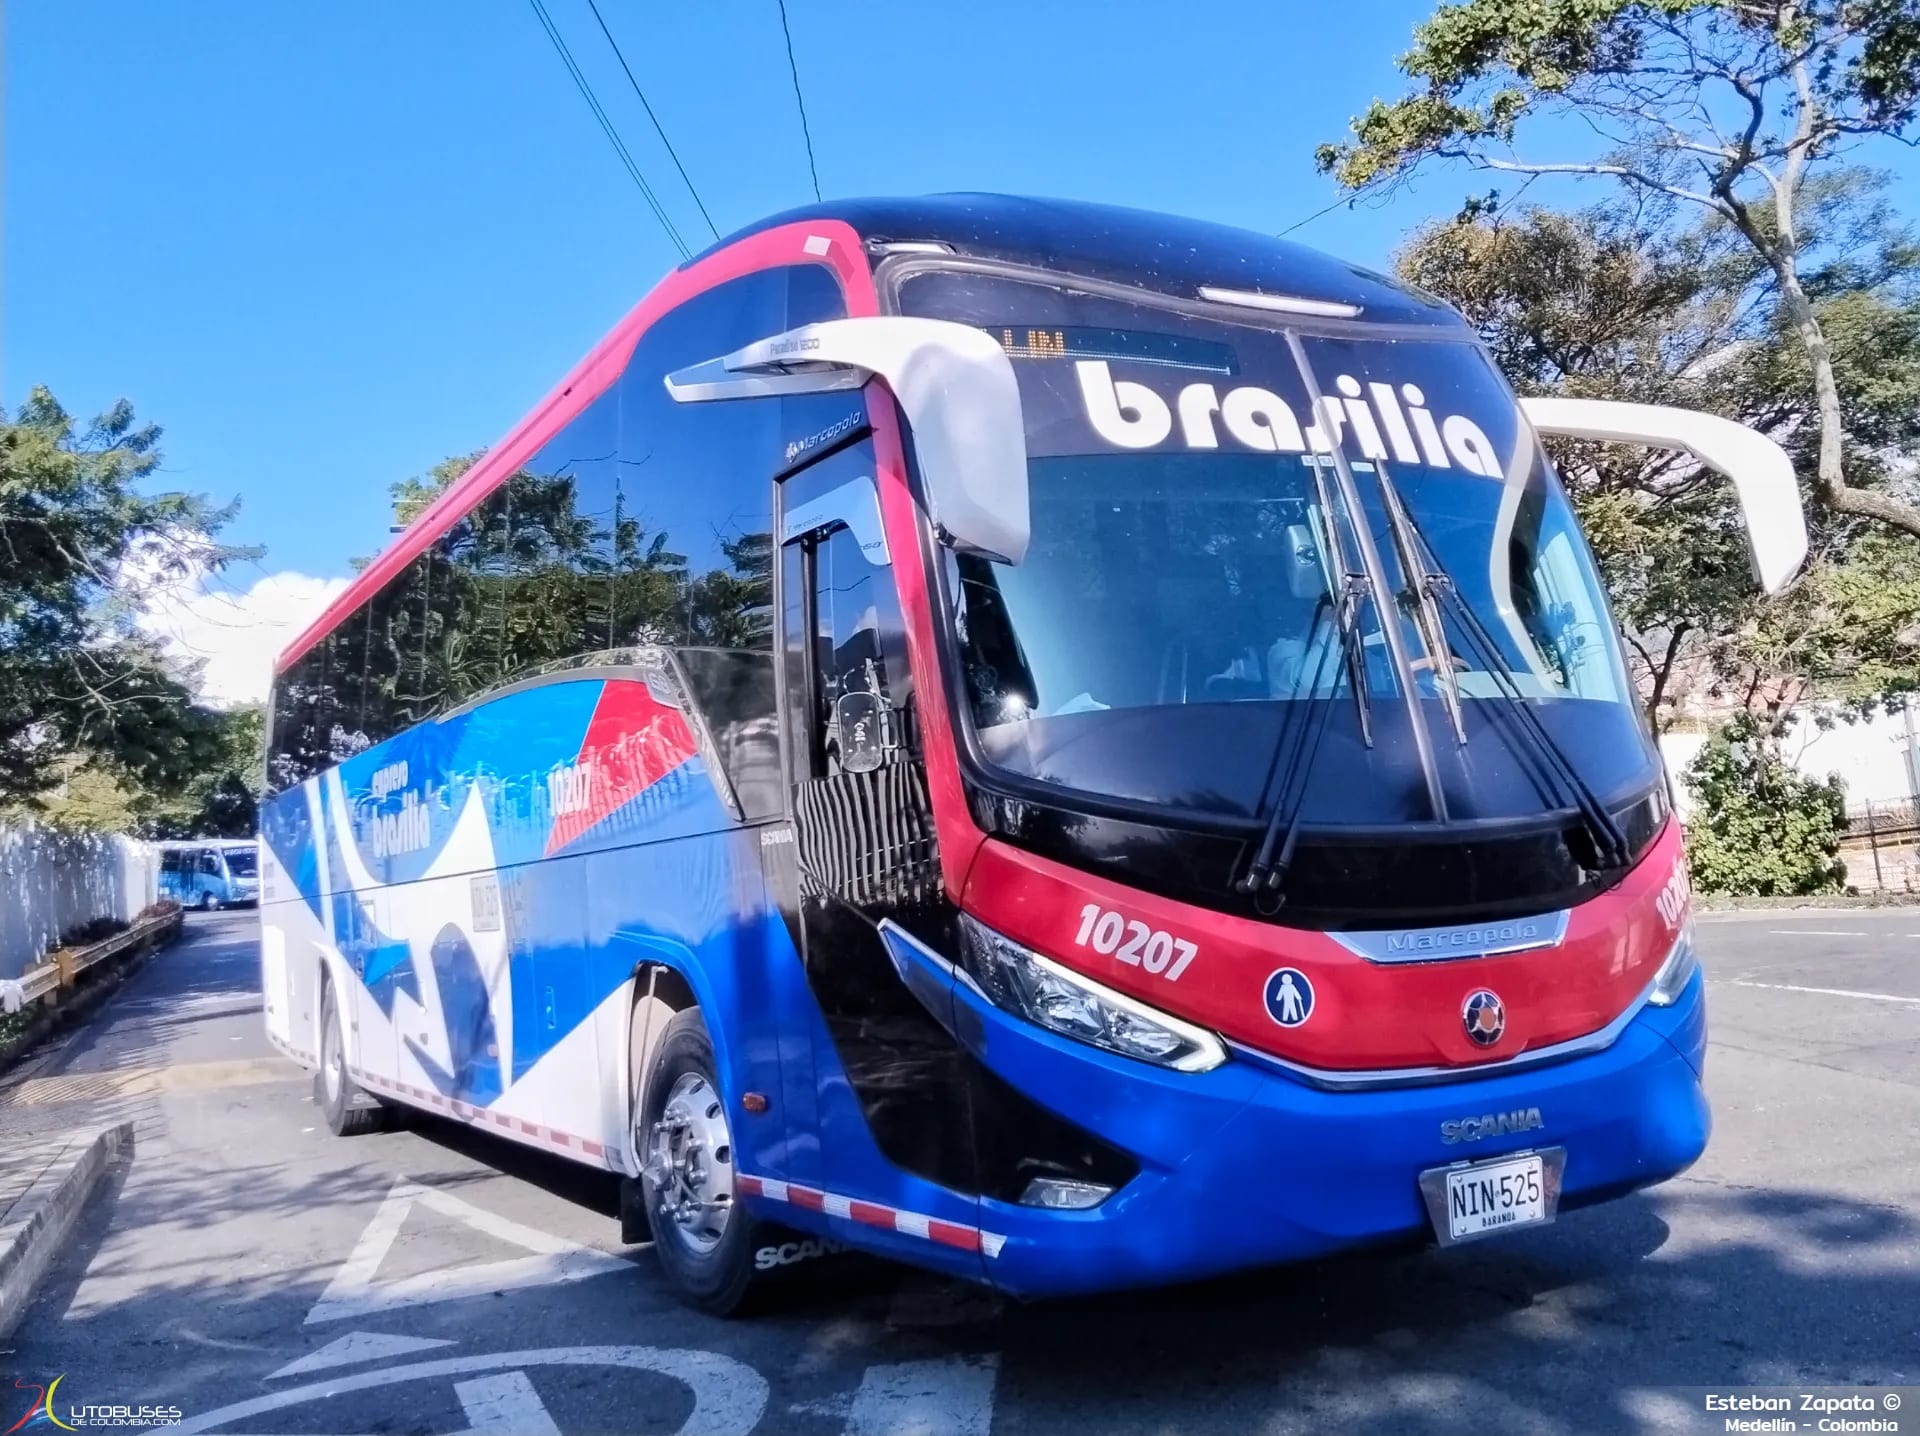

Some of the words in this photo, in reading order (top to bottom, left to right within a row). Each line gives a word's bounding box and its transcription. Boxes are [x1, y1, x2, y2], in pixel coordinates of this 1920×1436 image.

[982, 328, 1064, 358] LIN
[800, 411, 862, 451] Marcopolo
[1076, 361, 1504, 480] brasilia
[547, 761, 591, 816] 10207
[373, 788, 431, 858] brasilia
[1074, 904, 1198, 981] 10207
[1386, 923, 1537, 952] Marcopolo
[1440, 1106, 1545, 1145] SCANIA
